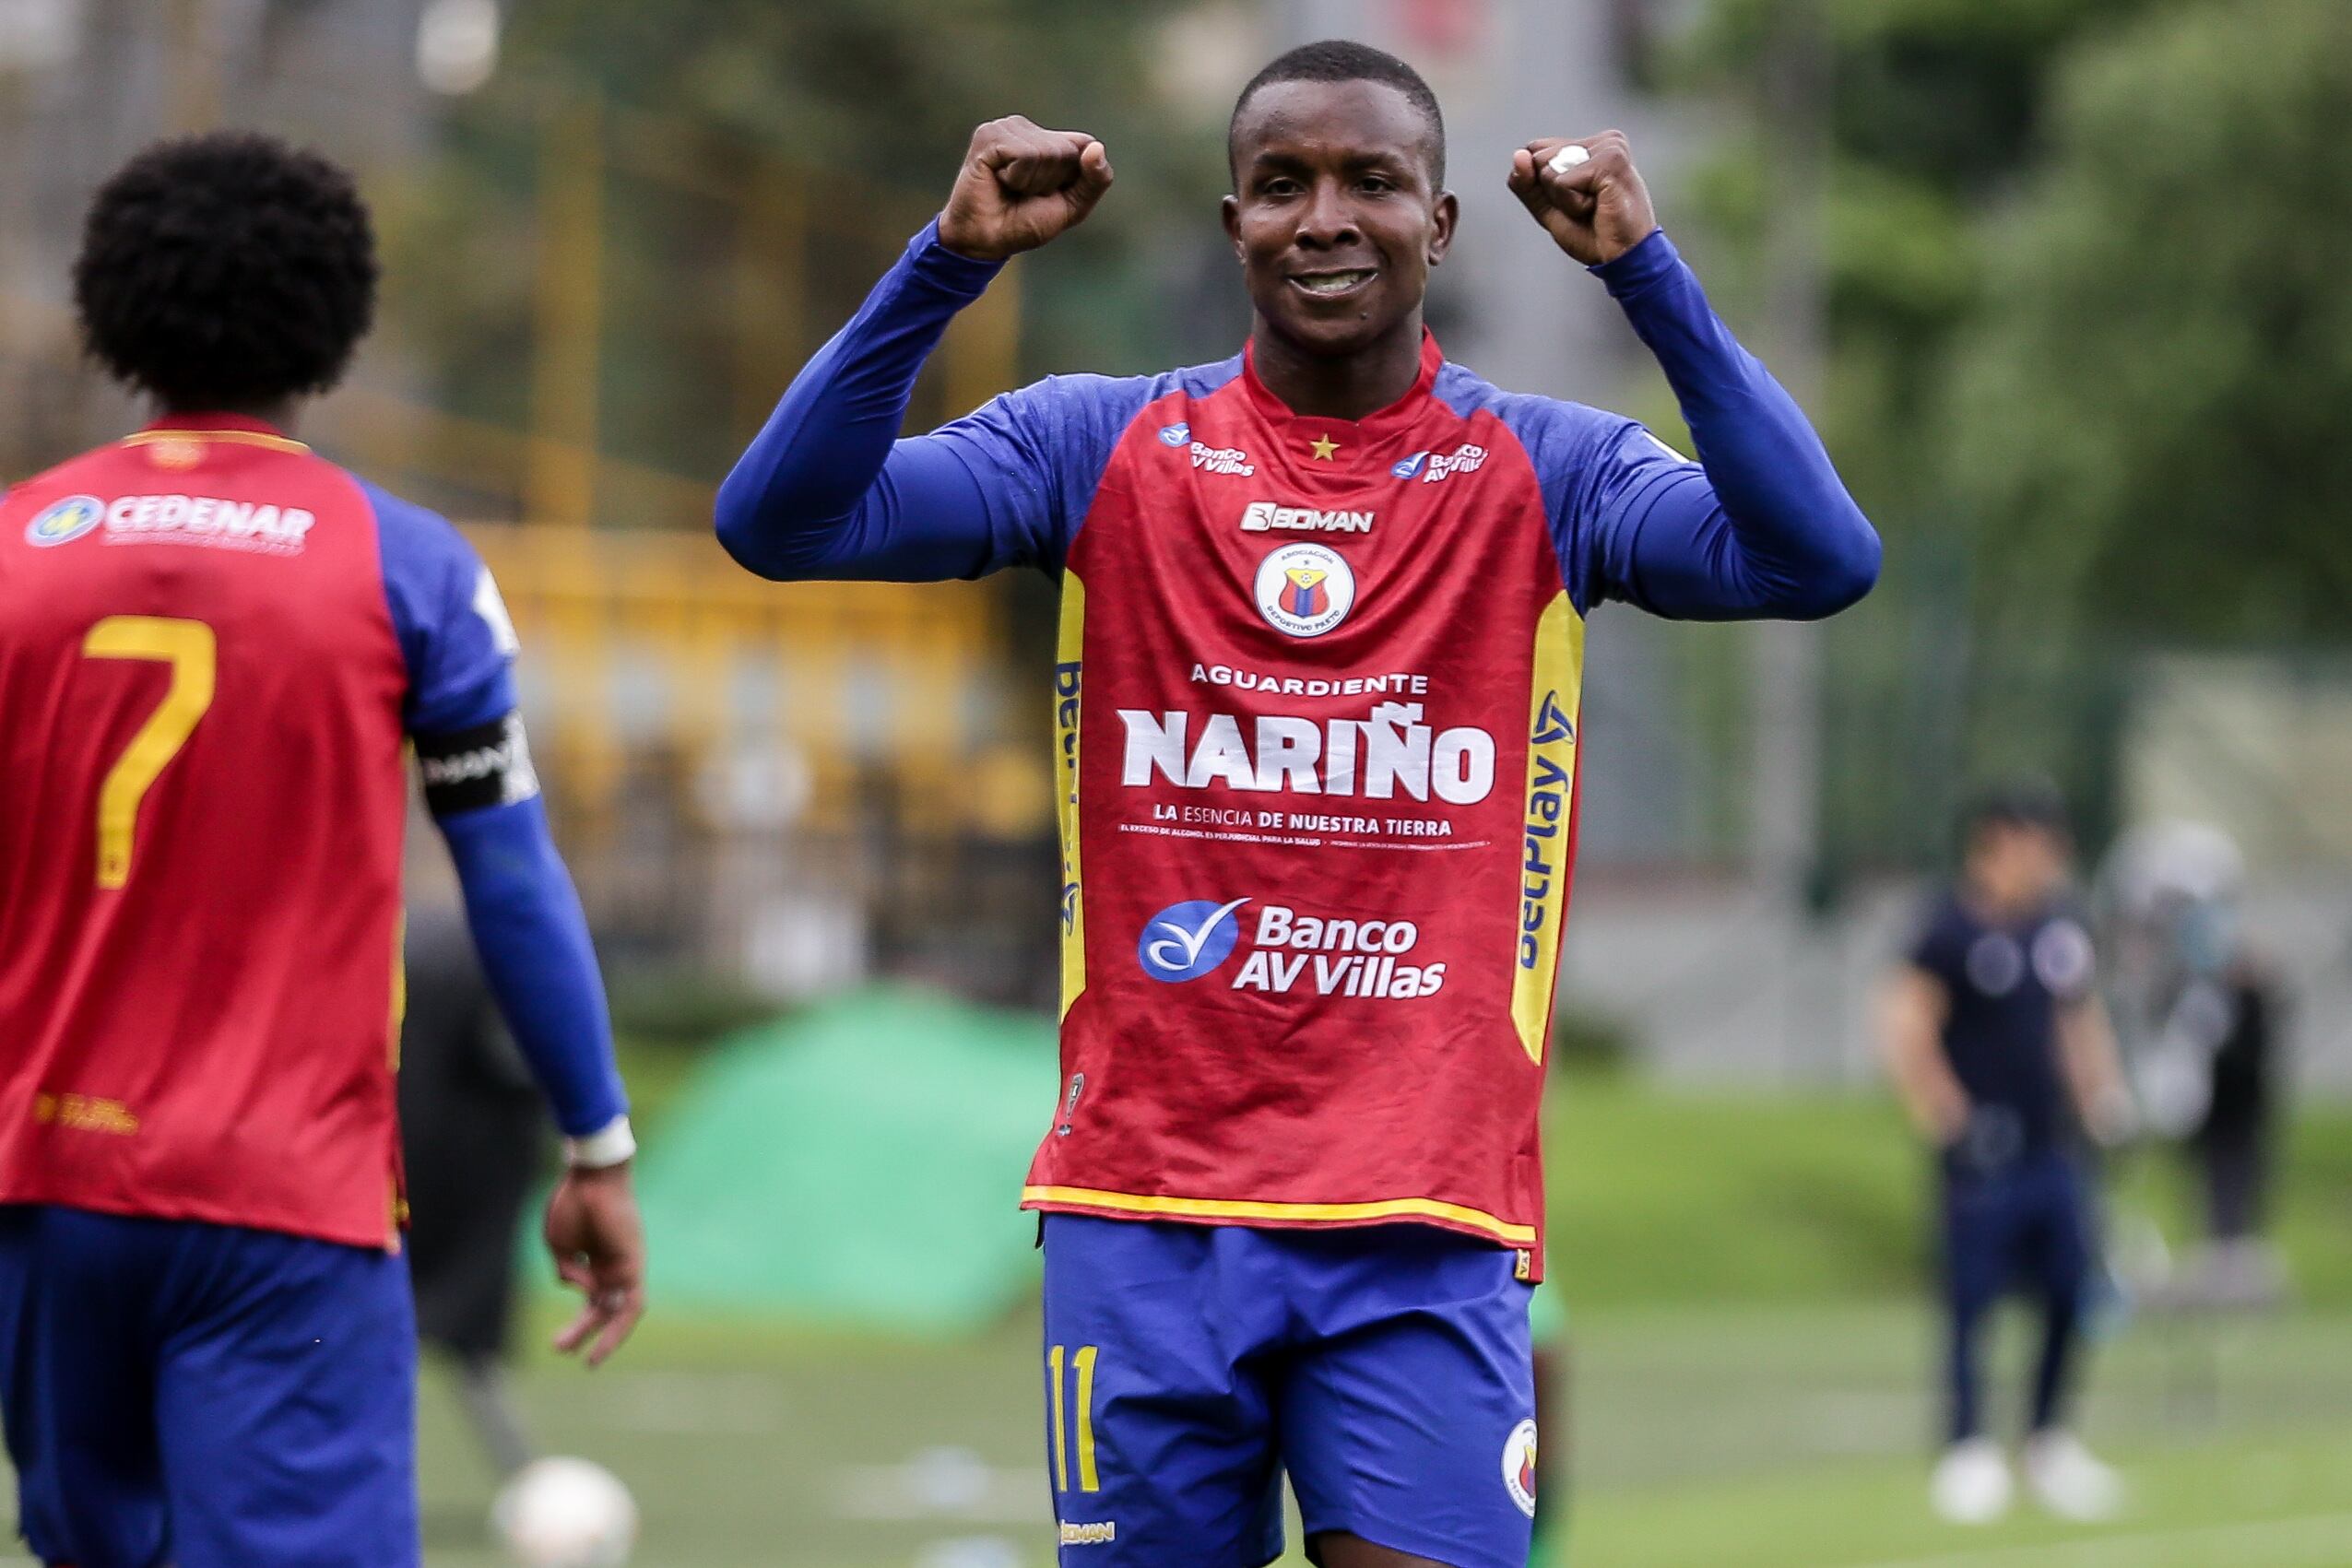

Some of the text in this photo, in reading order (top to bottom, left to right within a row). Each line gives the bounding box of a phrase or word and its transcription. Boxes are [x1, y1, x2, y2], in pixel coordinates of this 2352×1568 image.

[1190, 442, 1247, 462] Banco
[1205, 458, 1255, 477] Villas
[1423, 466, 1450, 483] AV
[106, 493, 316, 544] CEDENAR
[1271, 508, 1375, 533] BOMAN
[1191, 663, 1429, 696] AGUARDIENTE
[82, 614, 217, 890] 7
[1116, 701, 1495, 805] NARIÑO
[1153, 804, 1453, 836] LA ESENCIA DE NUESTRA TIERRA
[1254, 905, 1418, 954] Banco
[1231, 950, 1447, 999] AV Villas
[1049, 1344, 1100, 1492] 11
